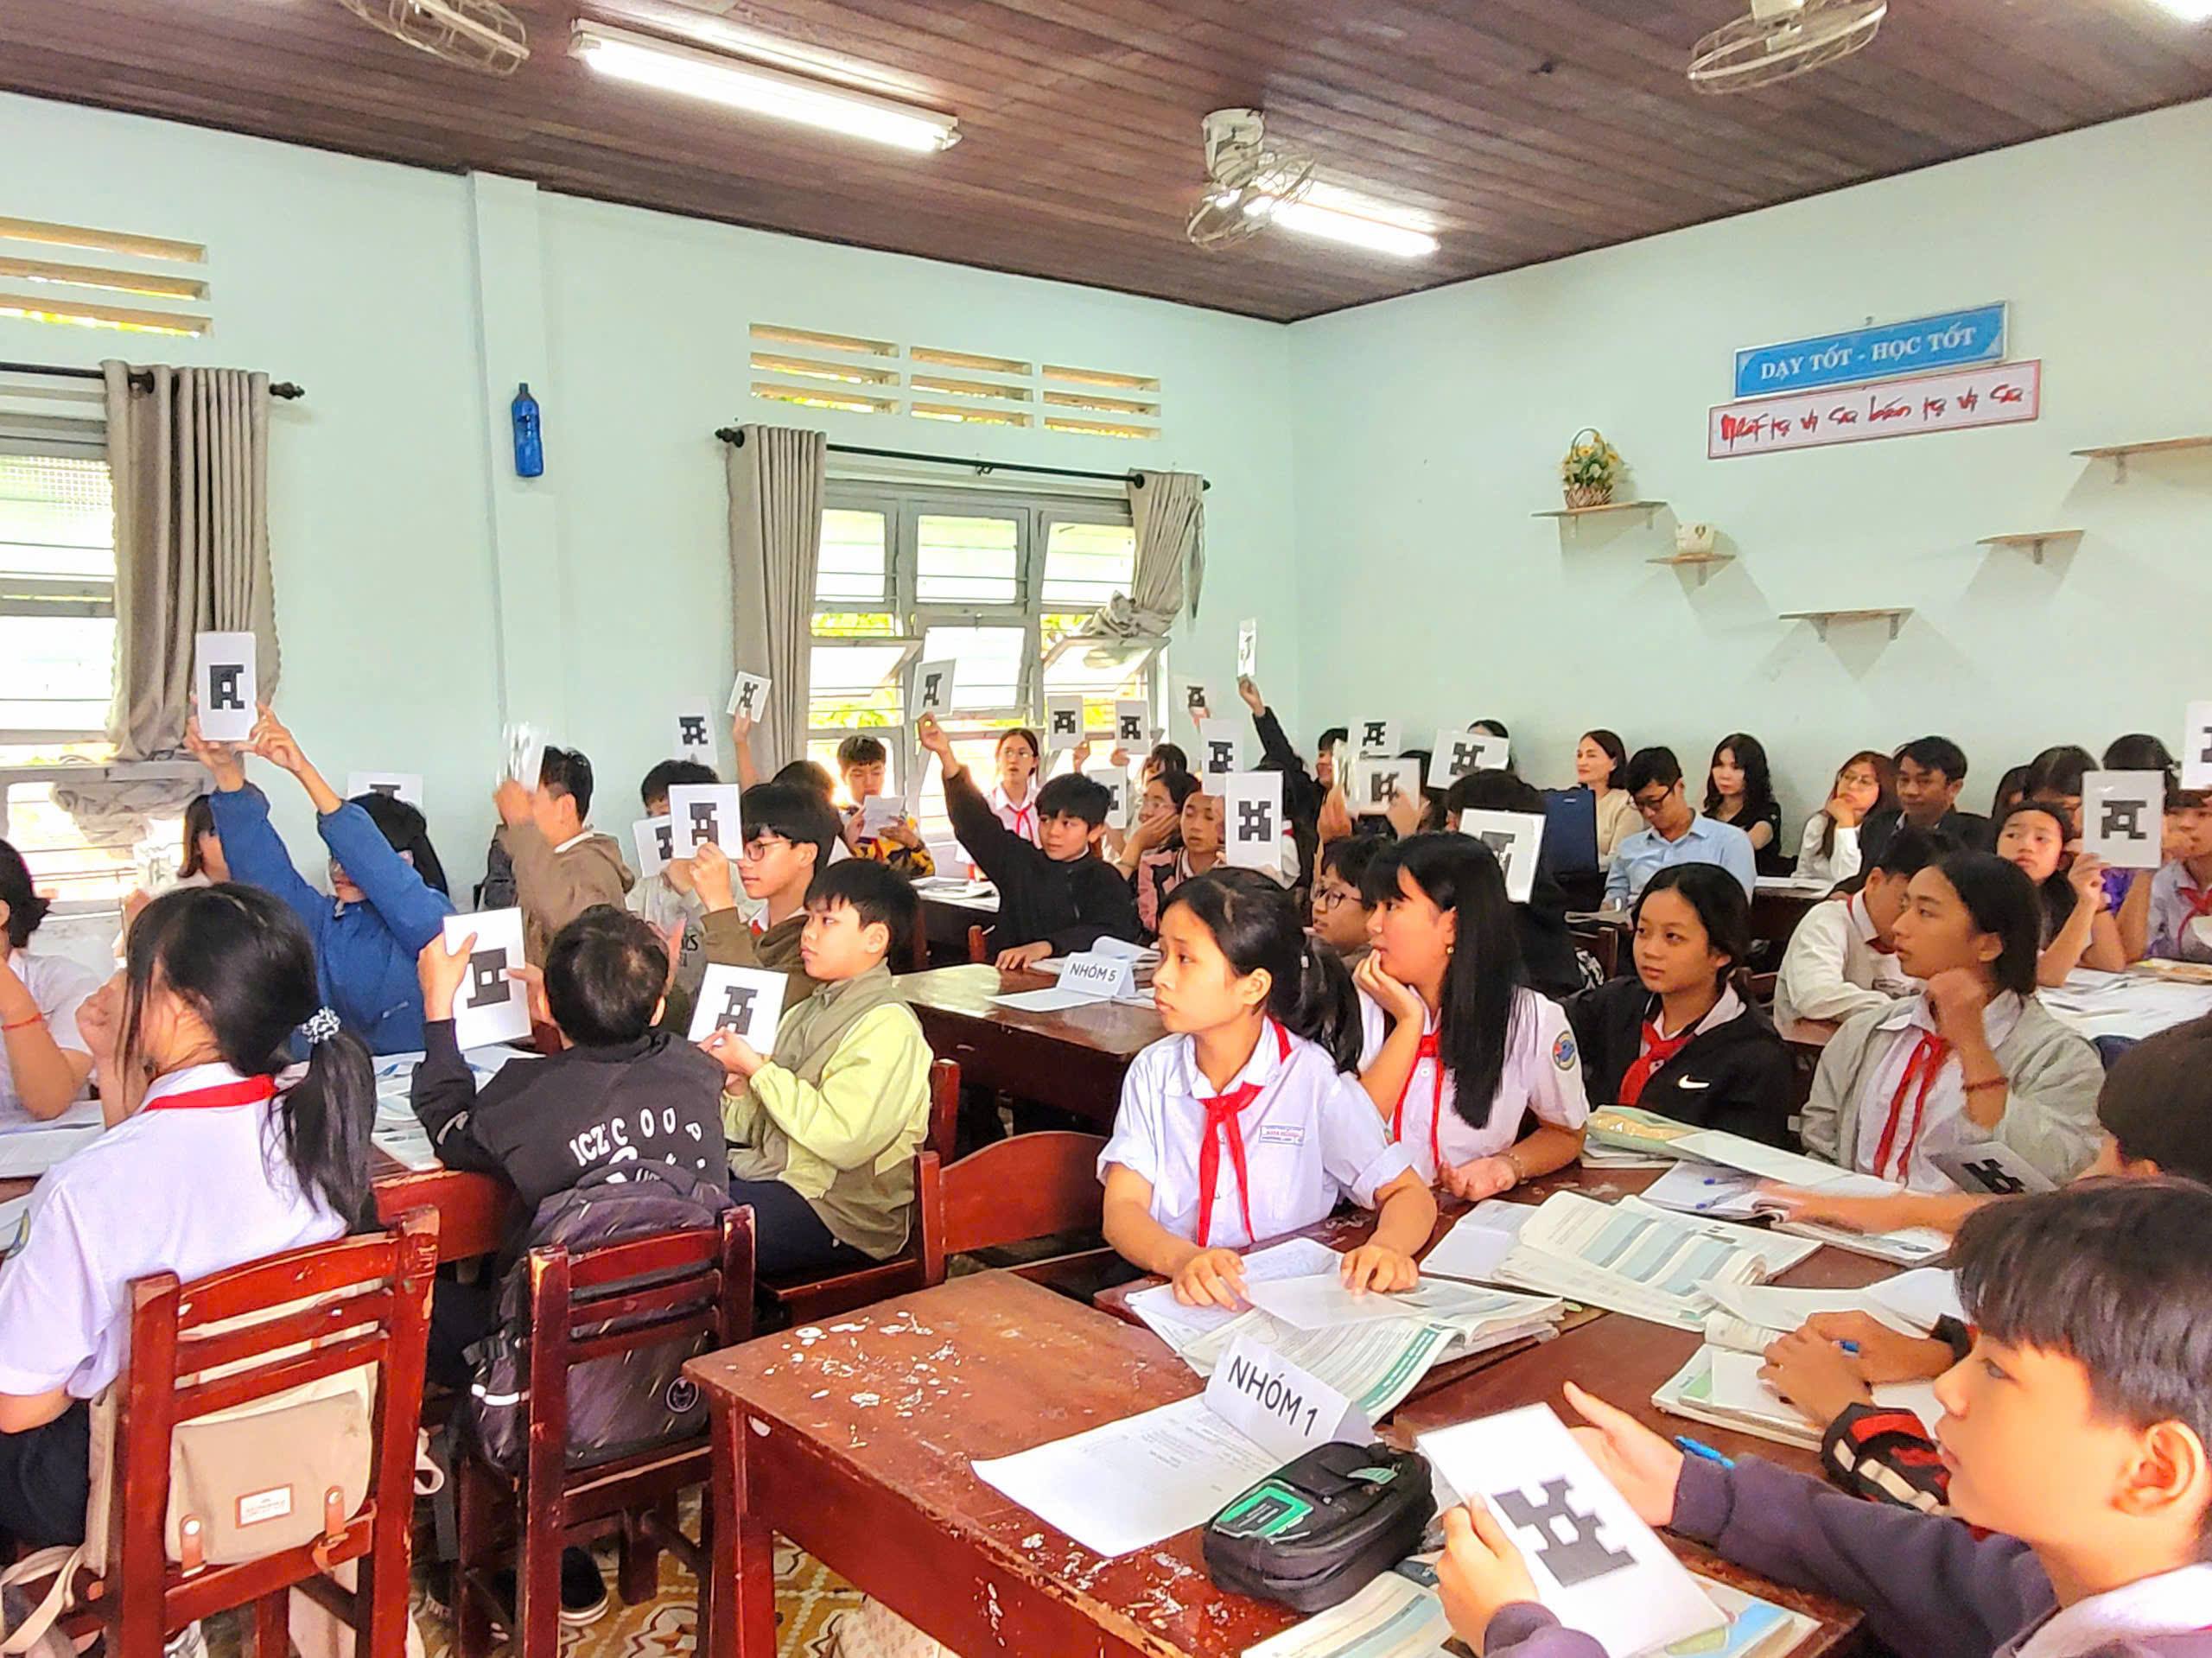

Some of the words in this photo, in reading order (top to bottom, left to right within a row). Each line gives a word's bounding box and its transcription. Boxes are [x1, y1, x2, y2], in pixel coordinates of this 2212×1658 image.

[1760, 355, 1805, 380] DẠY
[1808, 341, 1853, 372] TỐT
[1871, 334, 1923, 362] HỌC
[1927, 321, 1977, 353] TỐT
[1070, 962, 1108, 981] NHÓM
[1108, 969, 1117, 981] 5
[1227, 1354, 1303, 1426] NHÓM
[1303, 1407, 1319, 1438] 1
